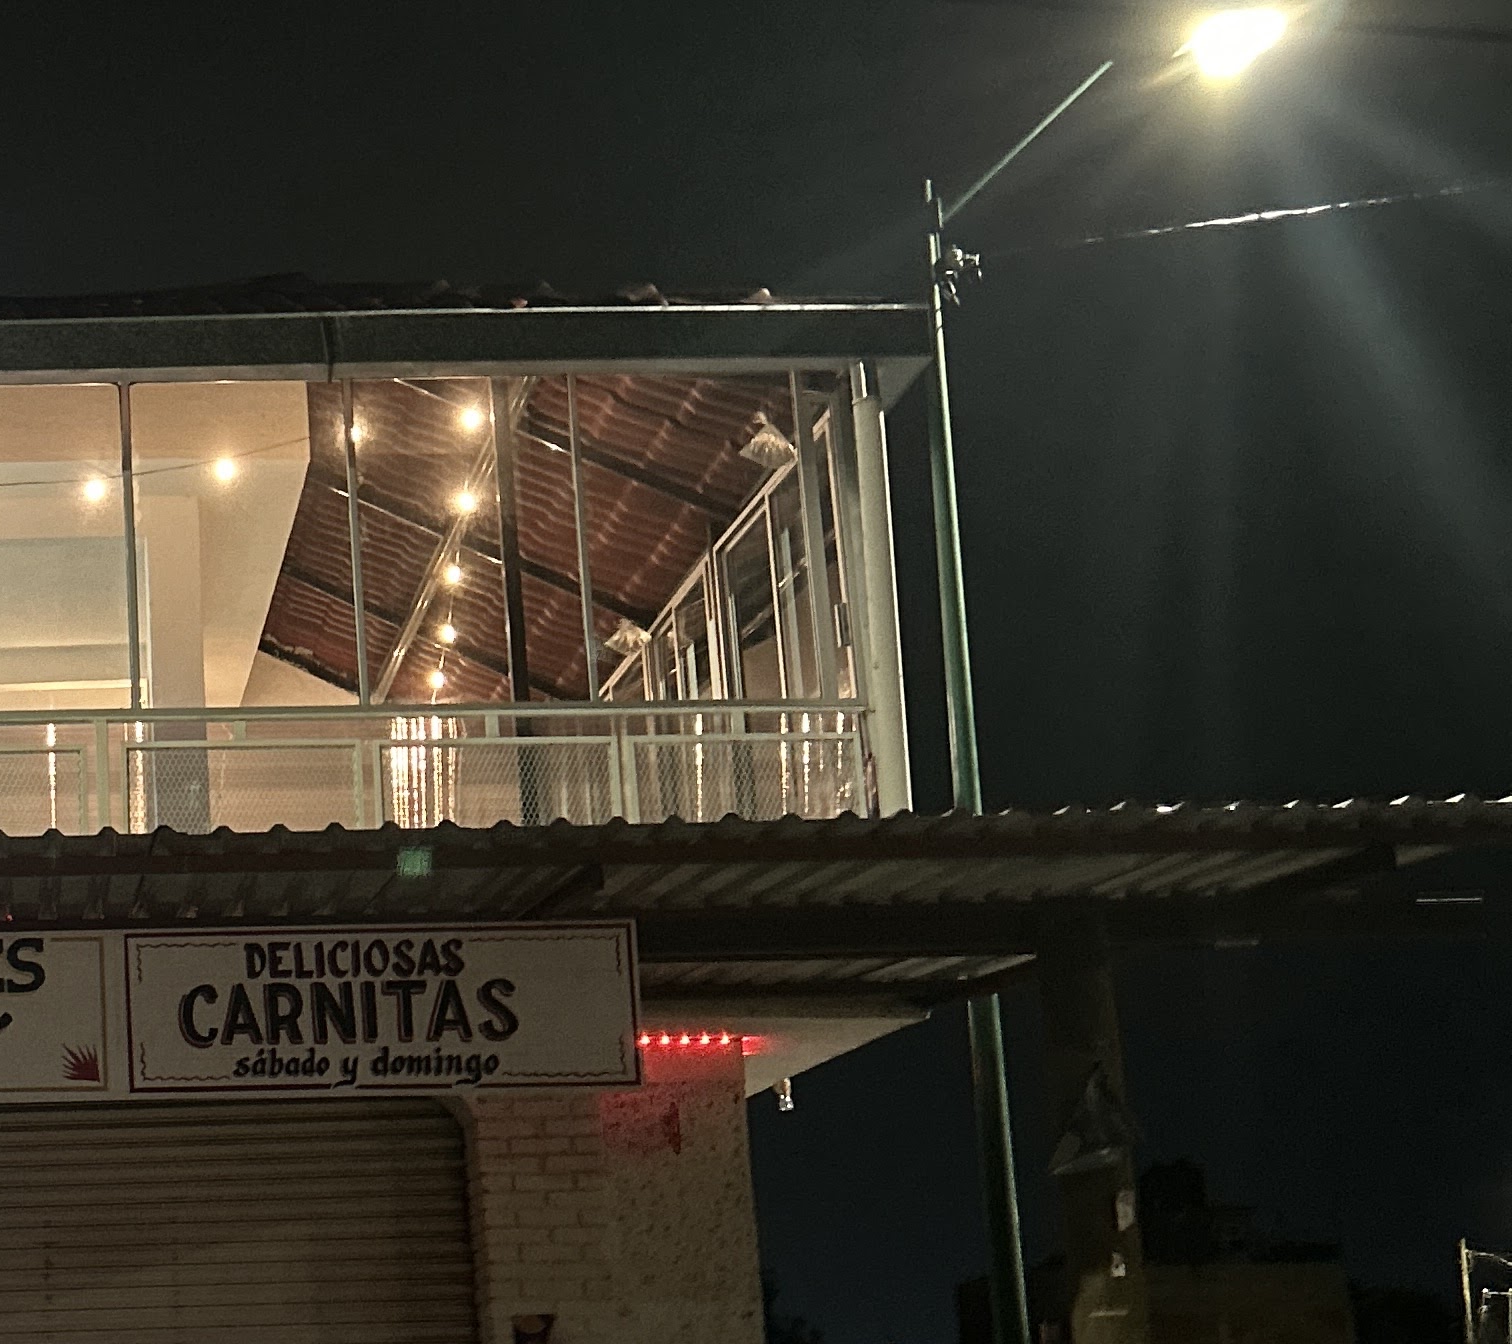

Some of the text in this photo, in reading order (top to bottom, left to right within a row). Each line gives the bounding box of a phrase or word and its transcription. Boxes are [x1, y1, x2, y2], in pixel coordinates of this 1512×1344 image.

[243, 938, 465, 981] DELICIOSAS
[178, 978, 520, 1048] CARNITAS
[232, 1046, 501, 1089] sábado y domingo
